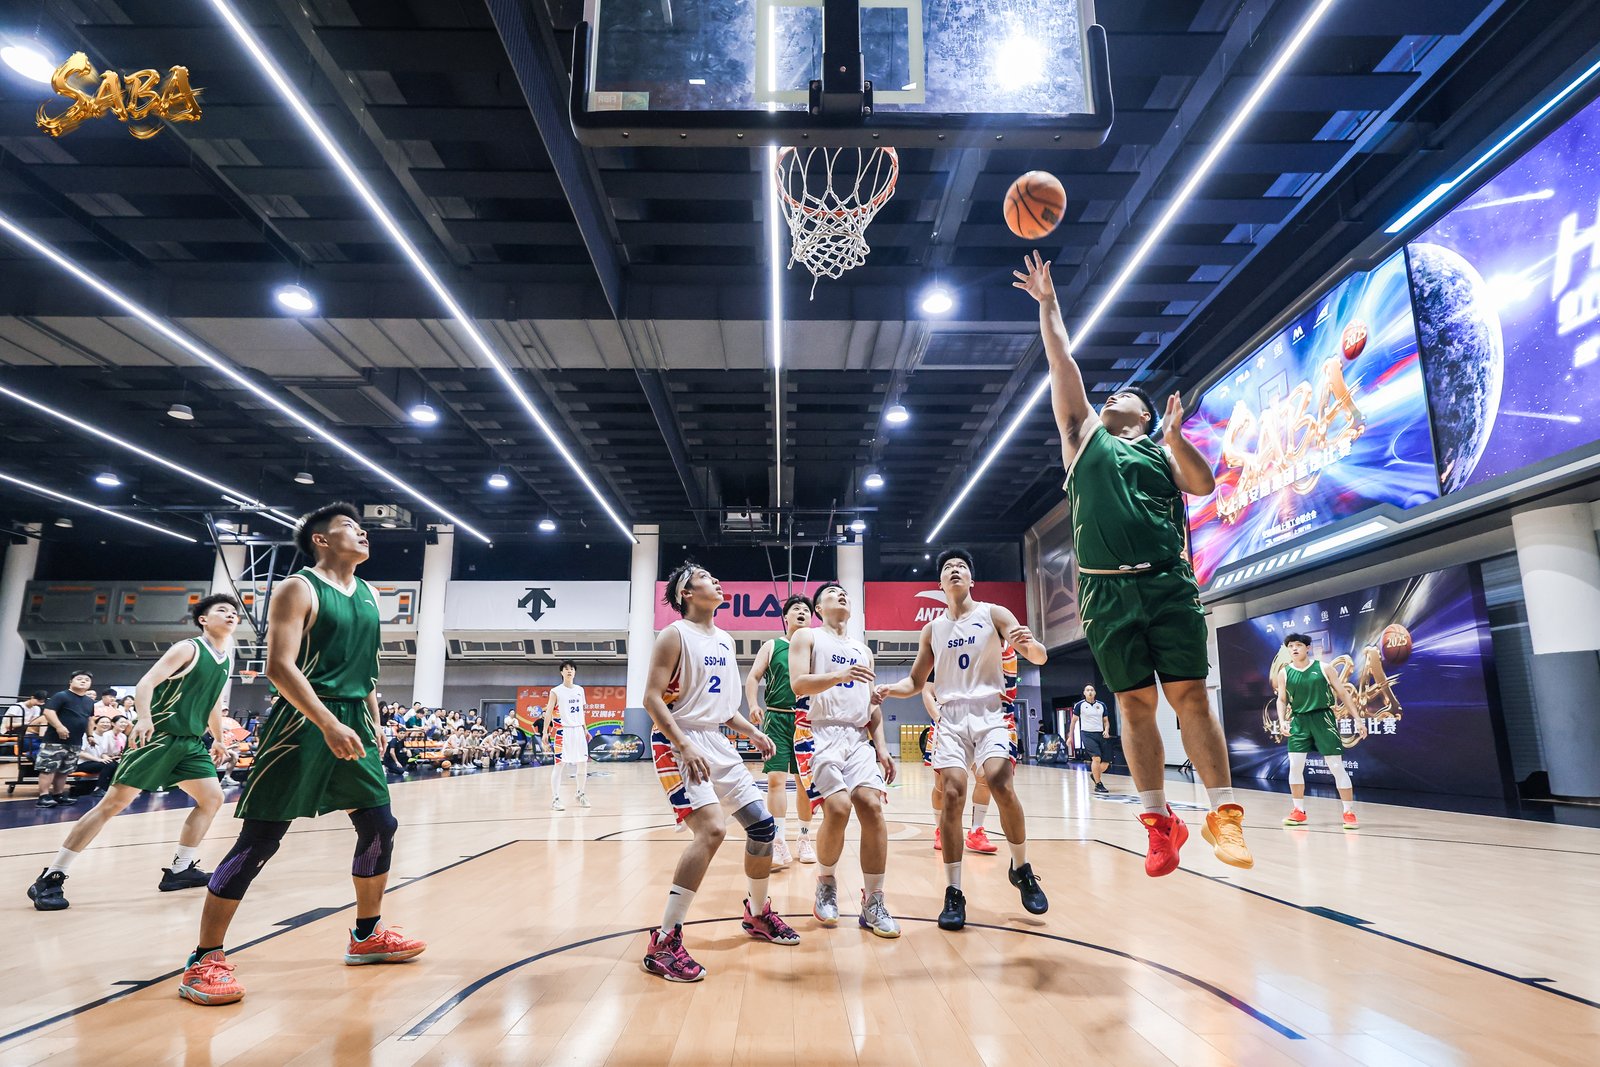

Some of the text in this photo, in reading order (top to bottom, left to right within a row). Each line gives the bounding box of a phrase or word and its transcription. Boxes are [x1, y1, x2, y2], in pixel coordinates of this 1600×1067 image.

[1344, 326, 1367, 350] 2025
[1216, 354, 1367, 526] SABA
[714, 593, 783, 618] FILA
[915, 607, 949, 622] ANT
[947, 636, 976, 649] SSD-M
[1386, 636, 1408, 648] 2025
[704, 655, 726, 667] SSD-M
[831, 654, 857, 665] SSD-M
[958, 653, 970, 670] 0
[708, 675, 721, 693] 2
